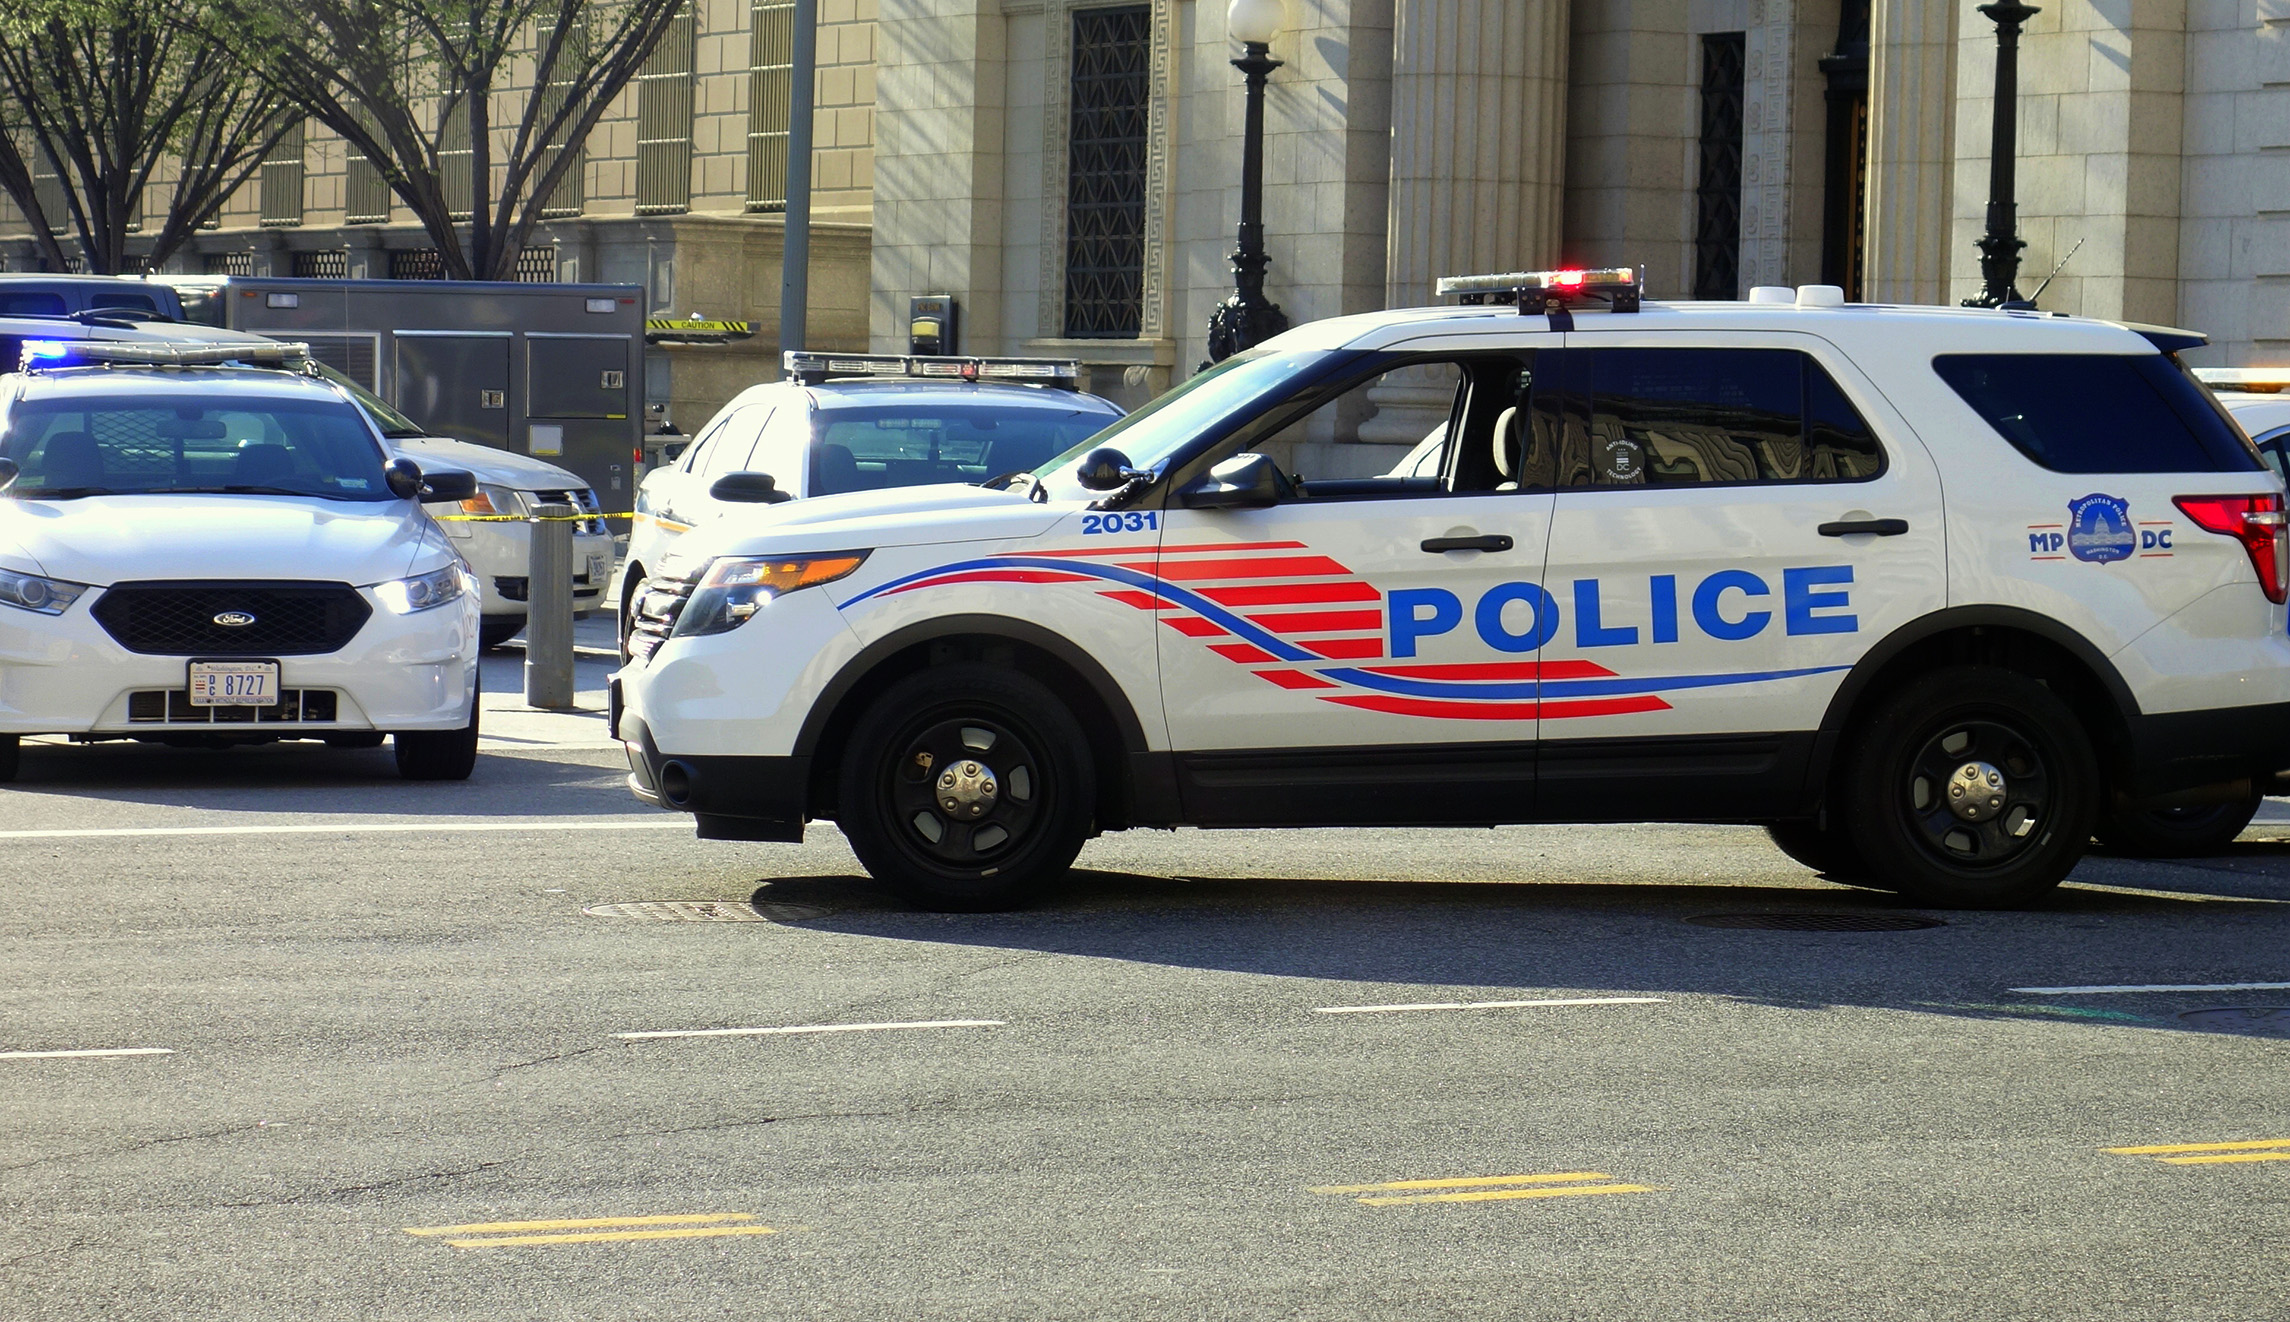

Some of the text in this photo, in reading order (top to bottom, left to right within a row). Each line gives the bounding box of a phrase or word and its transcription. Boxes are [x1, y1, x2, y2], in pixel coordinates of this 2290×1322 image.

[681, 321, 715, 329] CAUTION
[1606, 440, 1638, 451] ANTI-IDLING
[1606, 466, 1641, 479] TECHNOLOGY
[2075, 497, 2127, 528] METROPOLITAN POLICE
[1082, 511, 1158, 535] 2031
[2028, 529, 2173, 552] MP DC
[2085, 547, 2120, 555] WASHINGTON
[222, 614, 246, 623] Ford
[1387, 564, 1860, 659] POLICE
[225, 674, 265, 696] 8727
